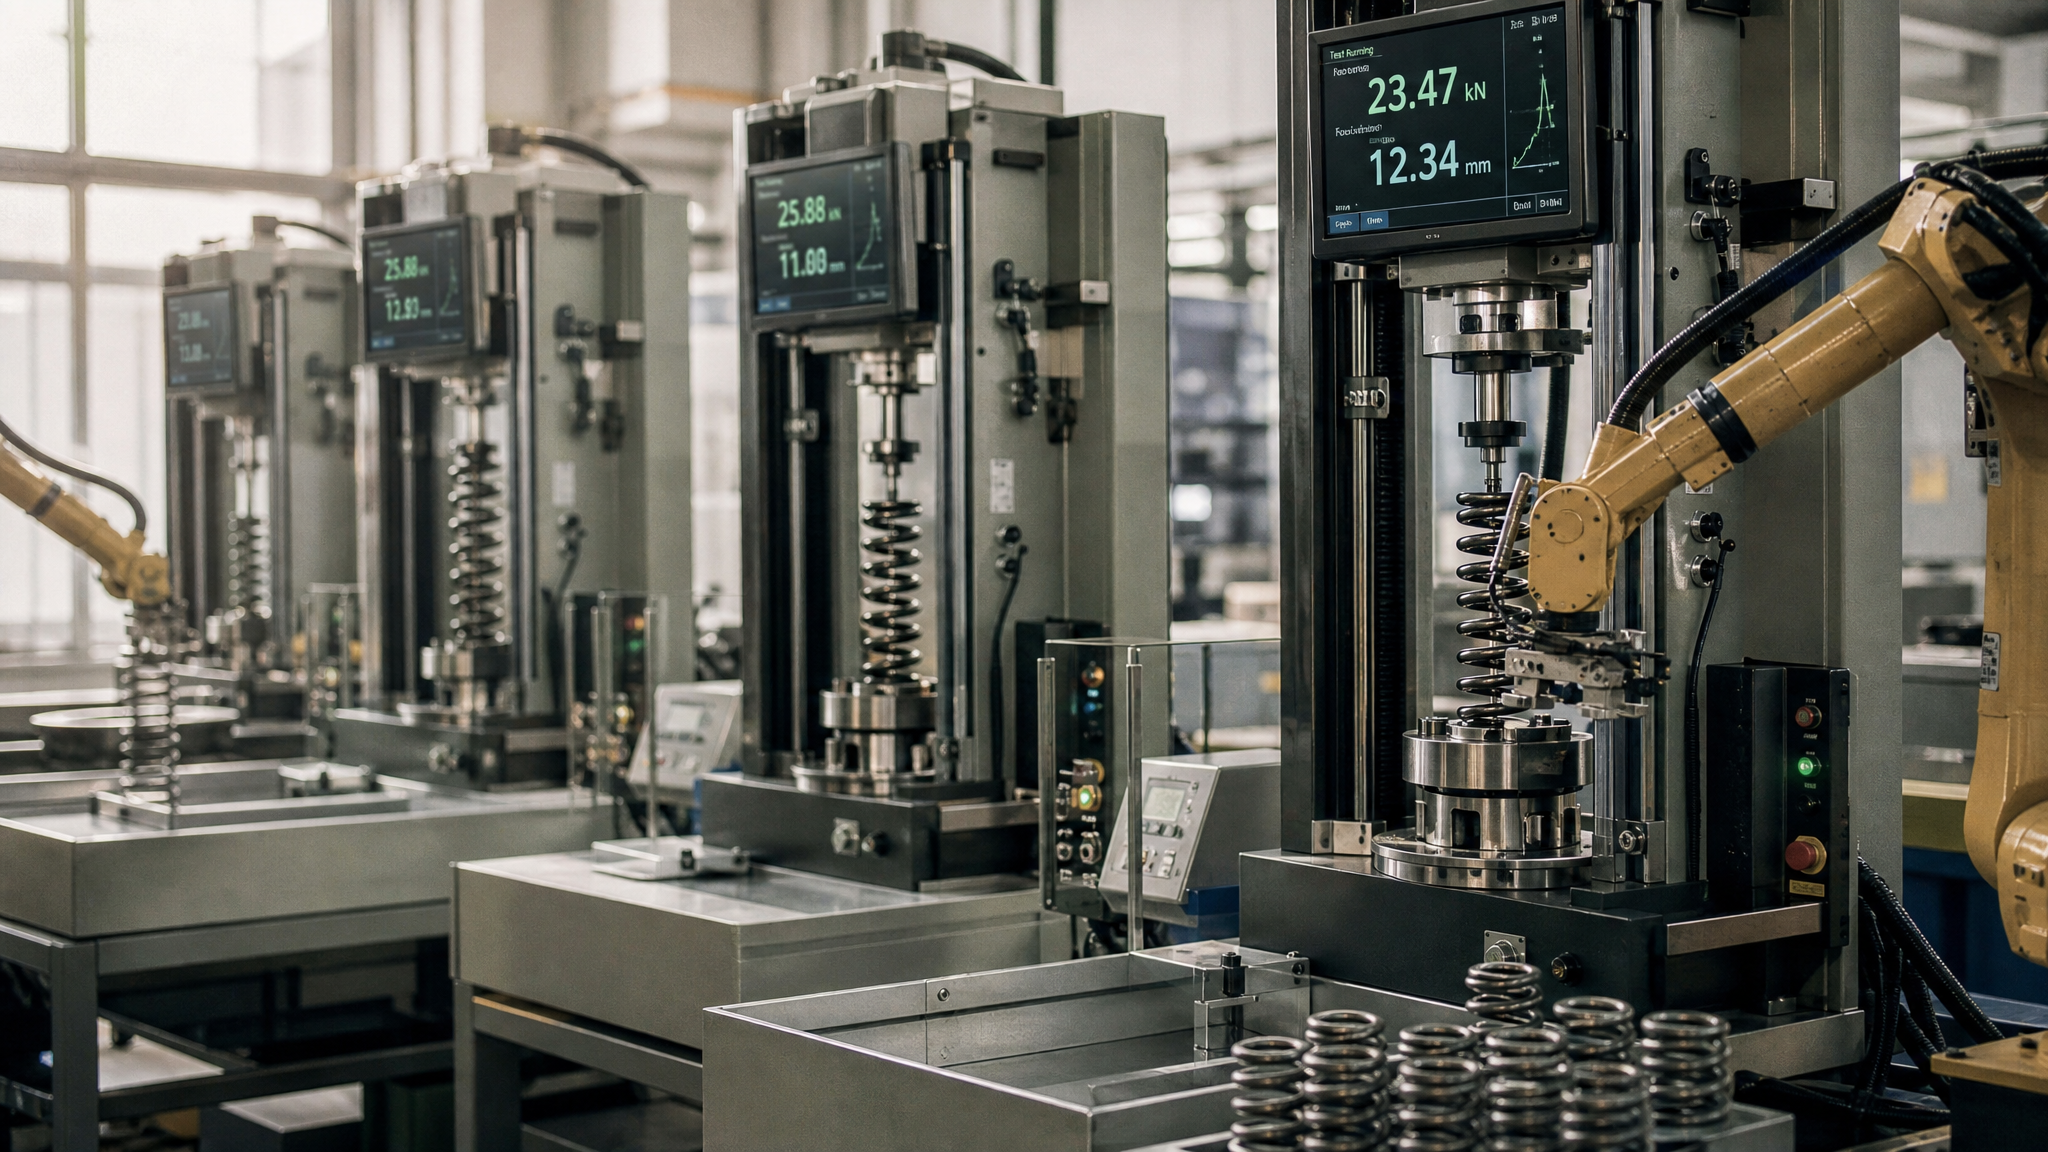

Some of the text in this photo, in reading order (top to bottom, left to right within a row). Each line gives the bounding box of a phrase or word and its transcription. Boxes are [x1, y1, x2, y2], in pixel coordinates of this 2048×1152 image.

[1329, 50, 1345, 60] Test
[1367, 66, 1486, 115] 23.47 kN
[1369, 139, 1491, 186] 12.34 mm
[777, 195, 826, 229] 25.88
